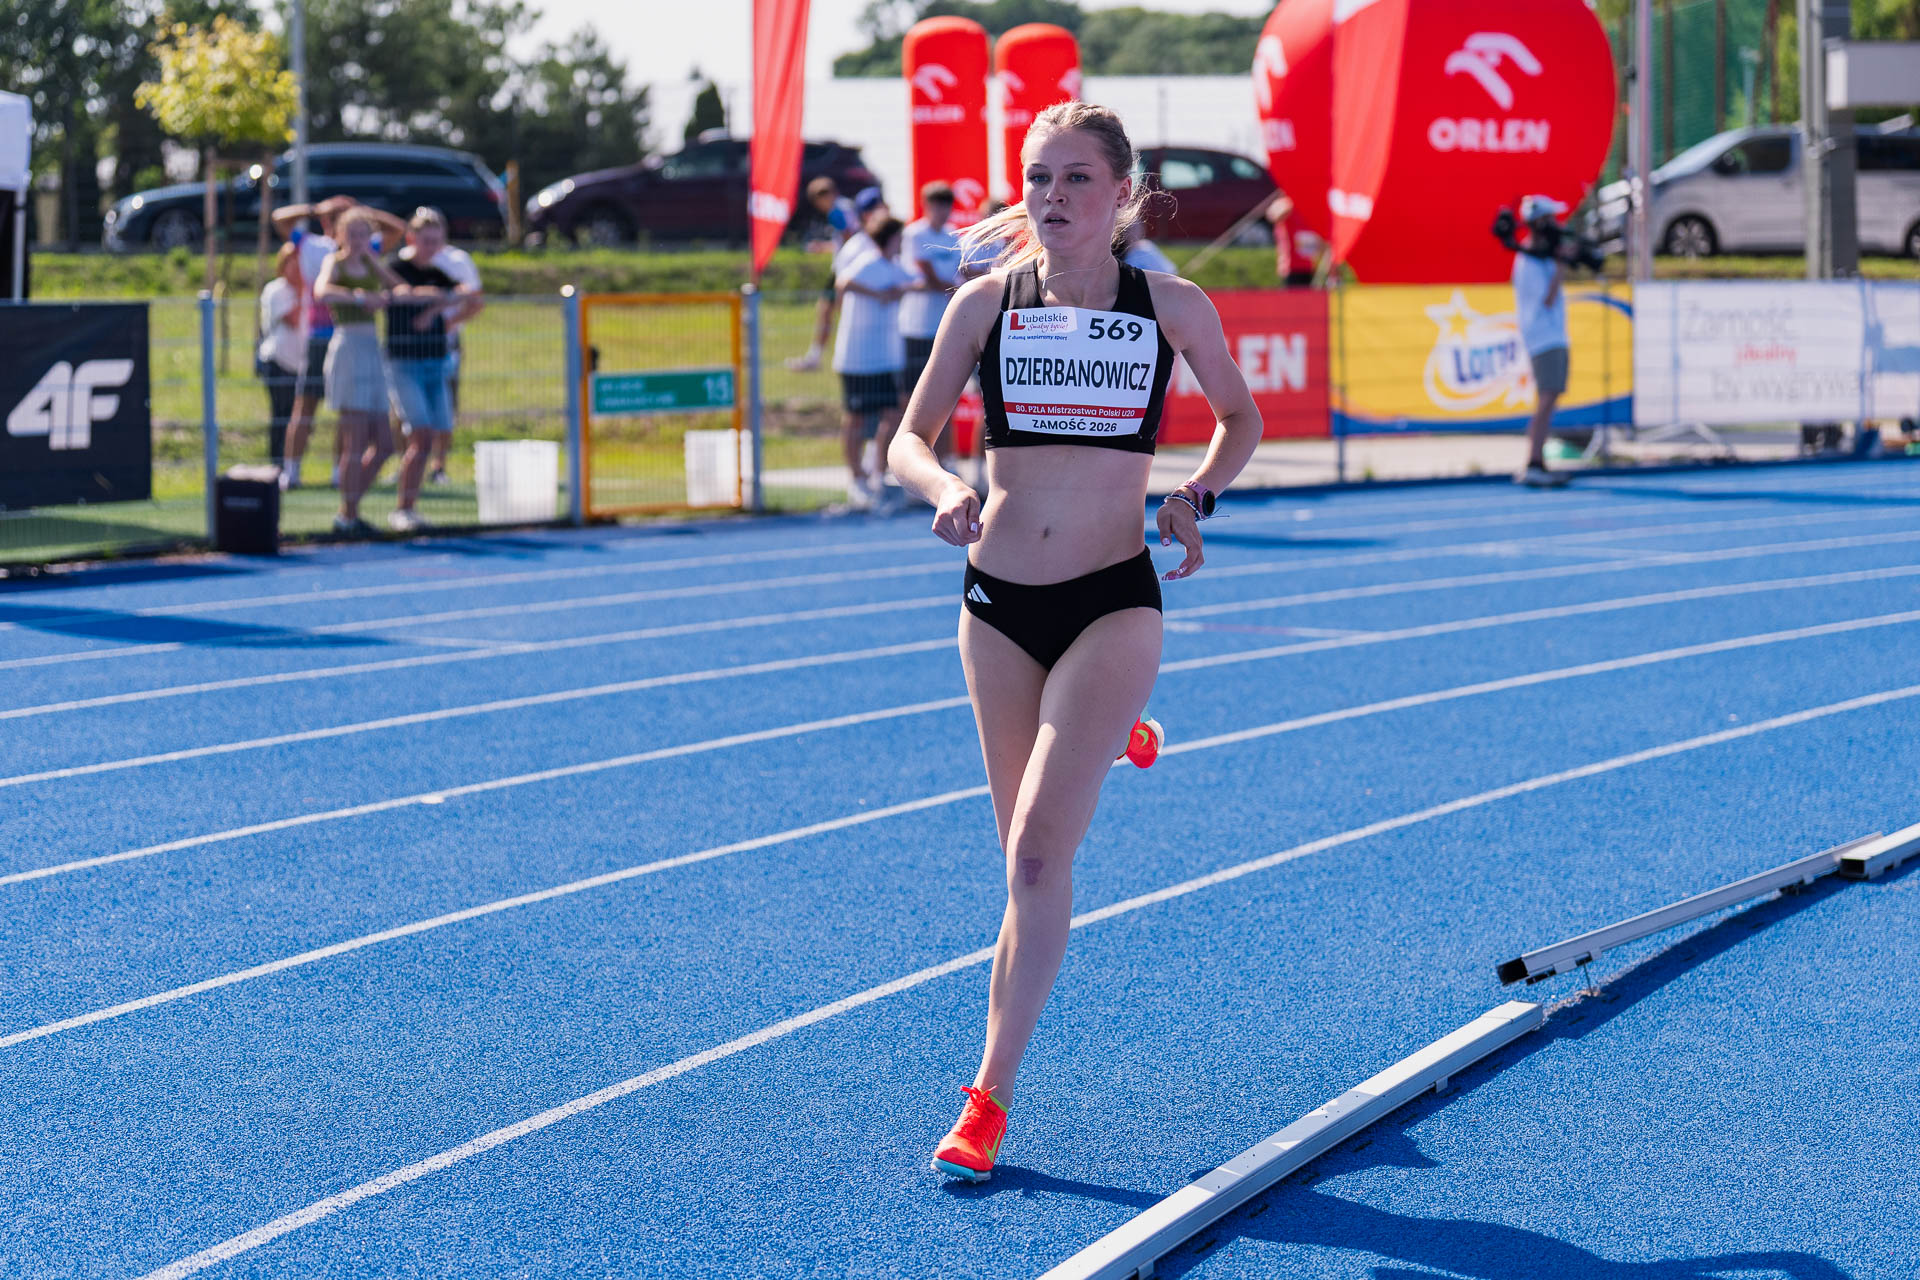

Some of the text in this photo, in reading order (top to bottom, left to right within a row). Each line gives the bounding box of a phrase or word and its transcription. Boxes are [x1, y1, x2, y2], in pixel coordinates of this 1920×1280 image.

[1427, 117, 1550, 153] ORLEN
[1088, 317, 1143, 342] 569
[1005, 357, 1151, 391] DZIERBANOWICZ
[1748, 372, 1862, 405] wygrywa
[6, 358, 135, 451] 4F
[1028, 405, 1046, 413] PZLA
[1047, 407, 1097, 416] Mistrzostwa
[1098, 409, 1120, 417] Polski
[1121, 410, 1136, 418] U20
[1032, 418, 1117, 432] ZAMOŚĆ 2026
